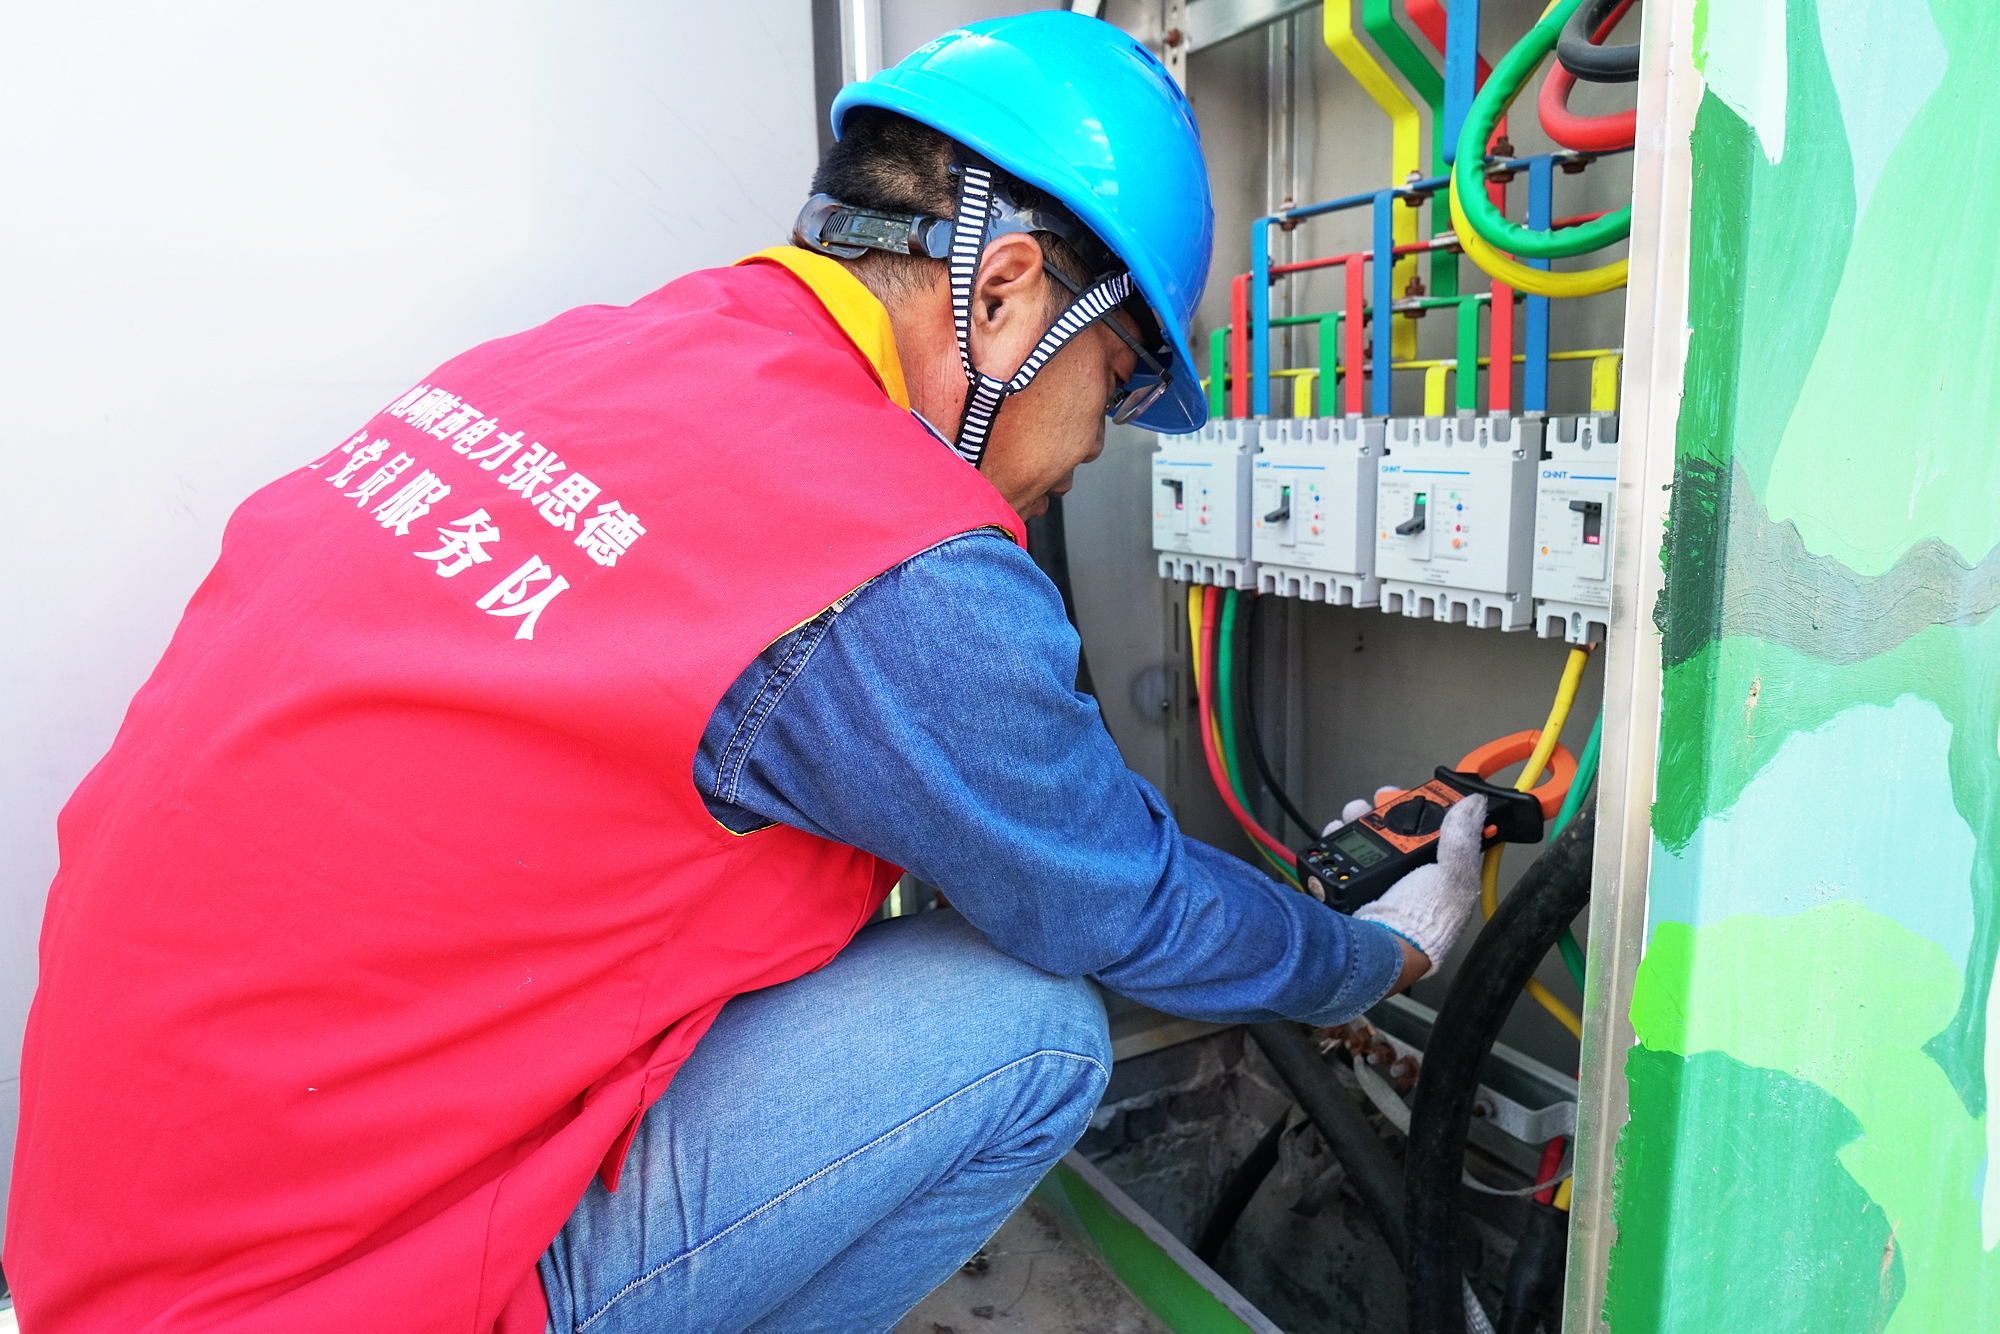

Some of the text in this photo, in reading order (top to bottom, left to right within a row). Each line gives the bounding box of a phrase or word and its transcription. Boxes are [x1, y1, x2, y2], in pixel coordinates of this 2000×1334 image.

[383, 384, 647, 567] 电网陕西电力张思德
[1542, 470, 1568, 479] CHNT
